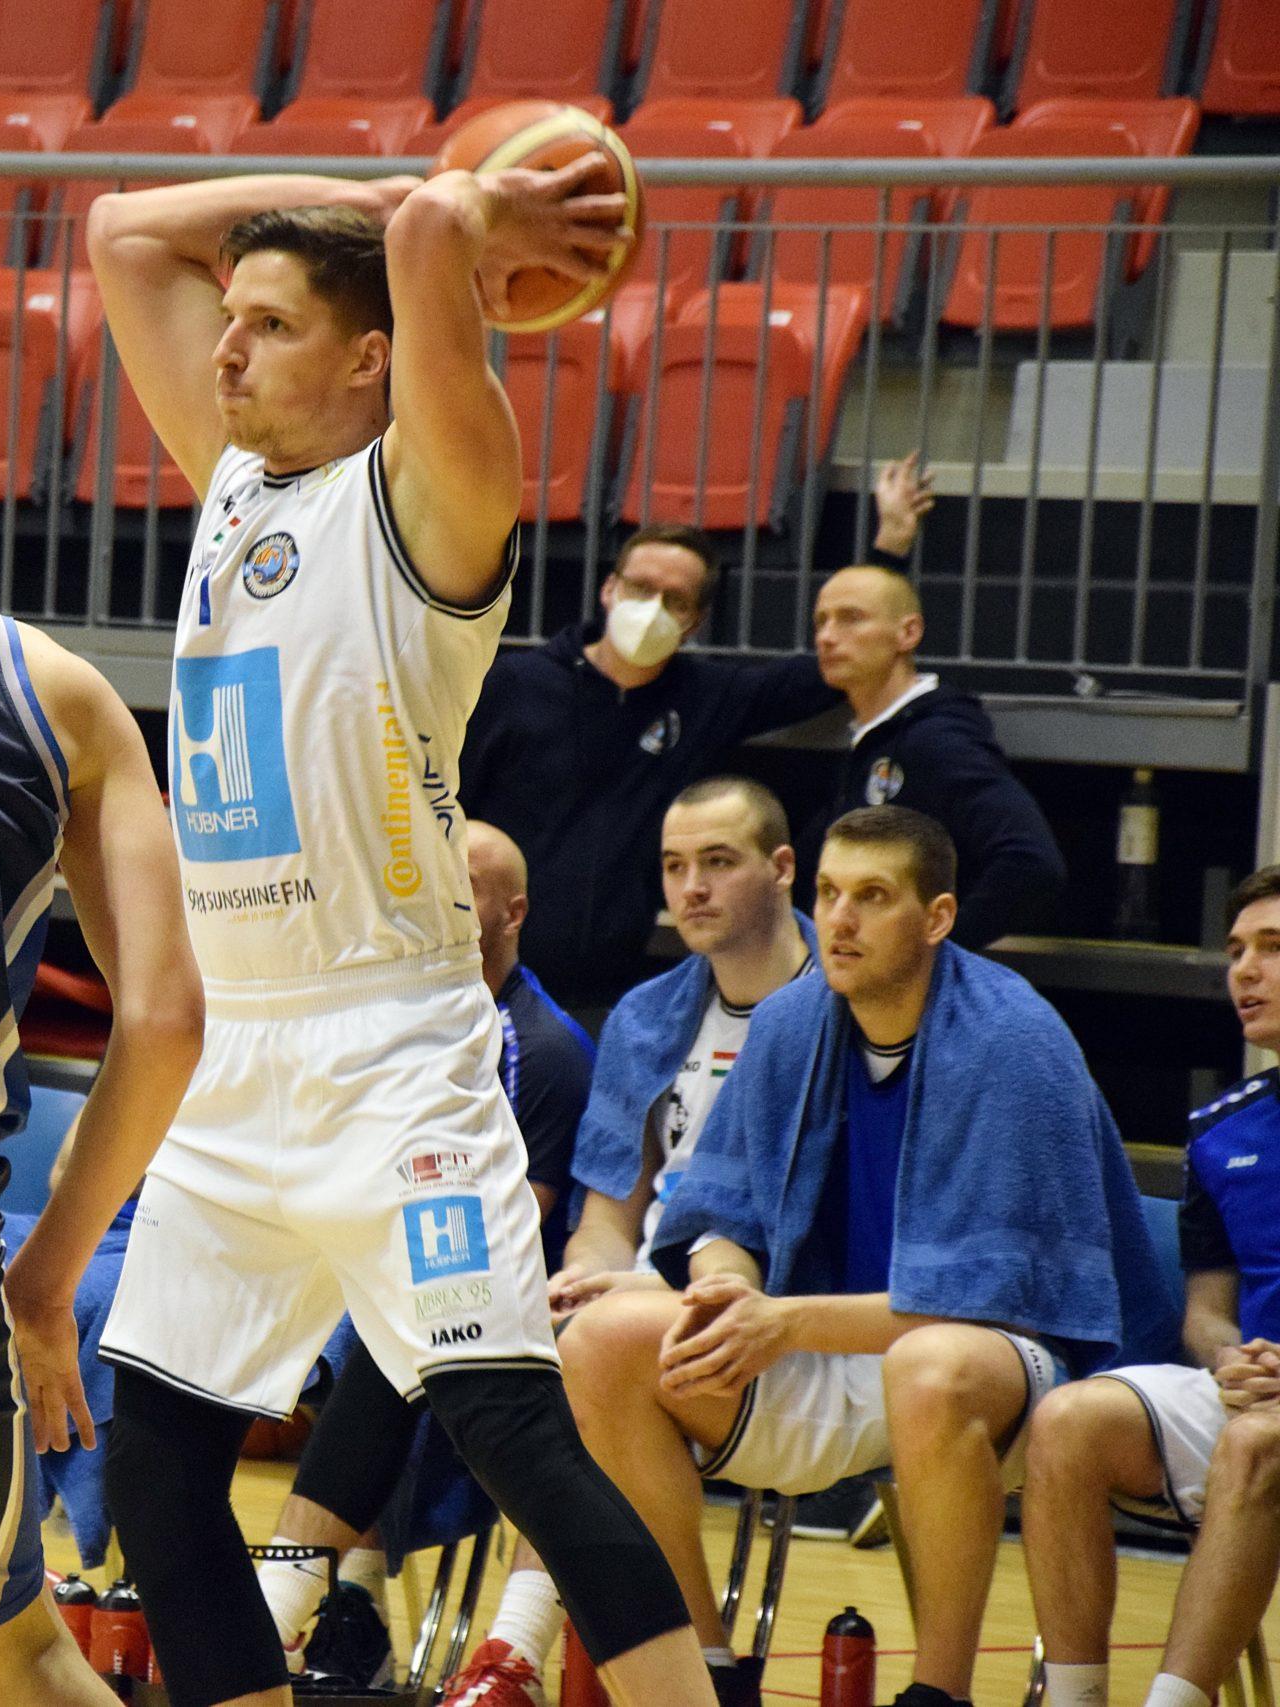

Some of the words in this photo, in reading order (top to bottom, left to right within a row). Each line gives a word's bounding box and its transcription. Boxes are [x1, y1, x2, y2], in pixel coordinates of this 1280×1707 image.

[378, 704, 423, 897] Continental
[280, 877, 317, 907] FM
[430, 1322, 483, 1348] JAKO
